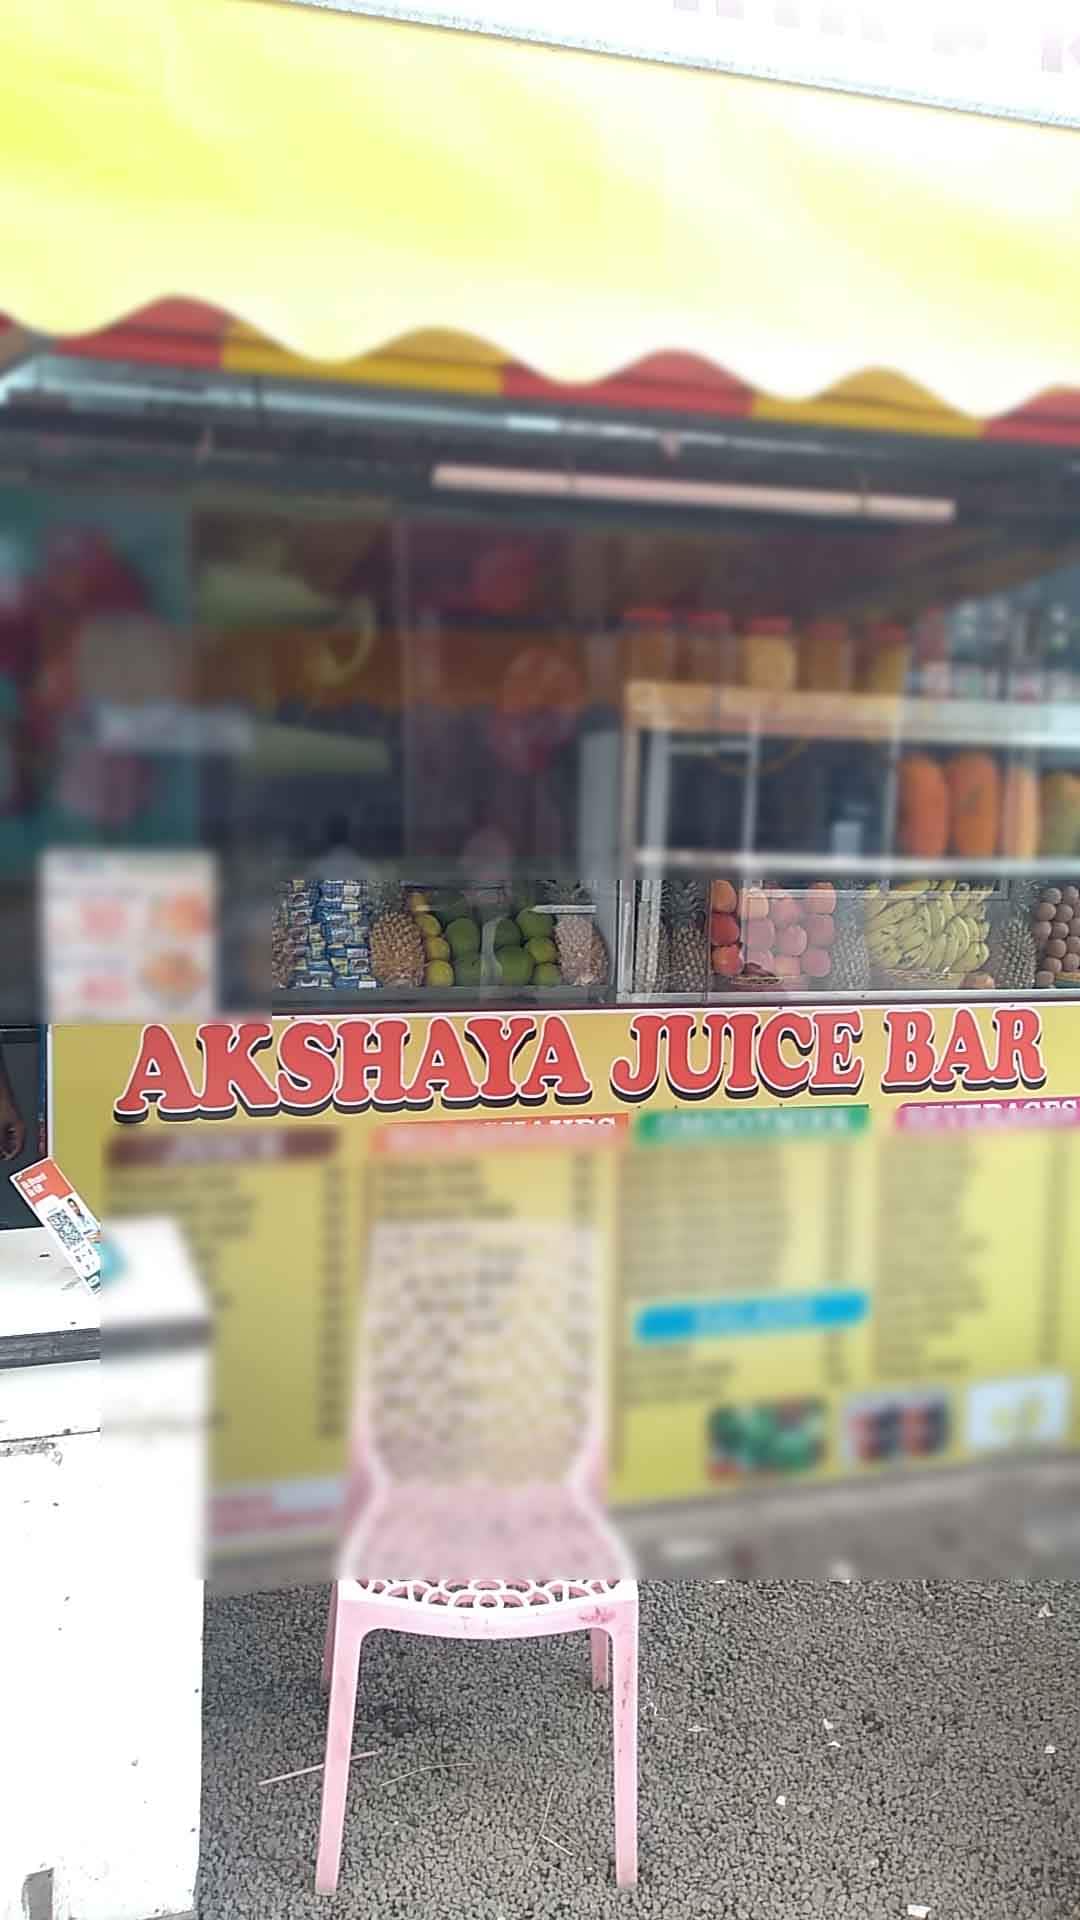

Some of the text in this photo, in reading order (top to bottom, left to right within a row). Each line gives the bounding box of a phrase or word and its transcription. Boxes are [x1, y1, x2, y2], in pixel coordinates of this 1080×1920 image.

[113, 1007, 1047, 1123] AKSHAYA JUICE BAR
